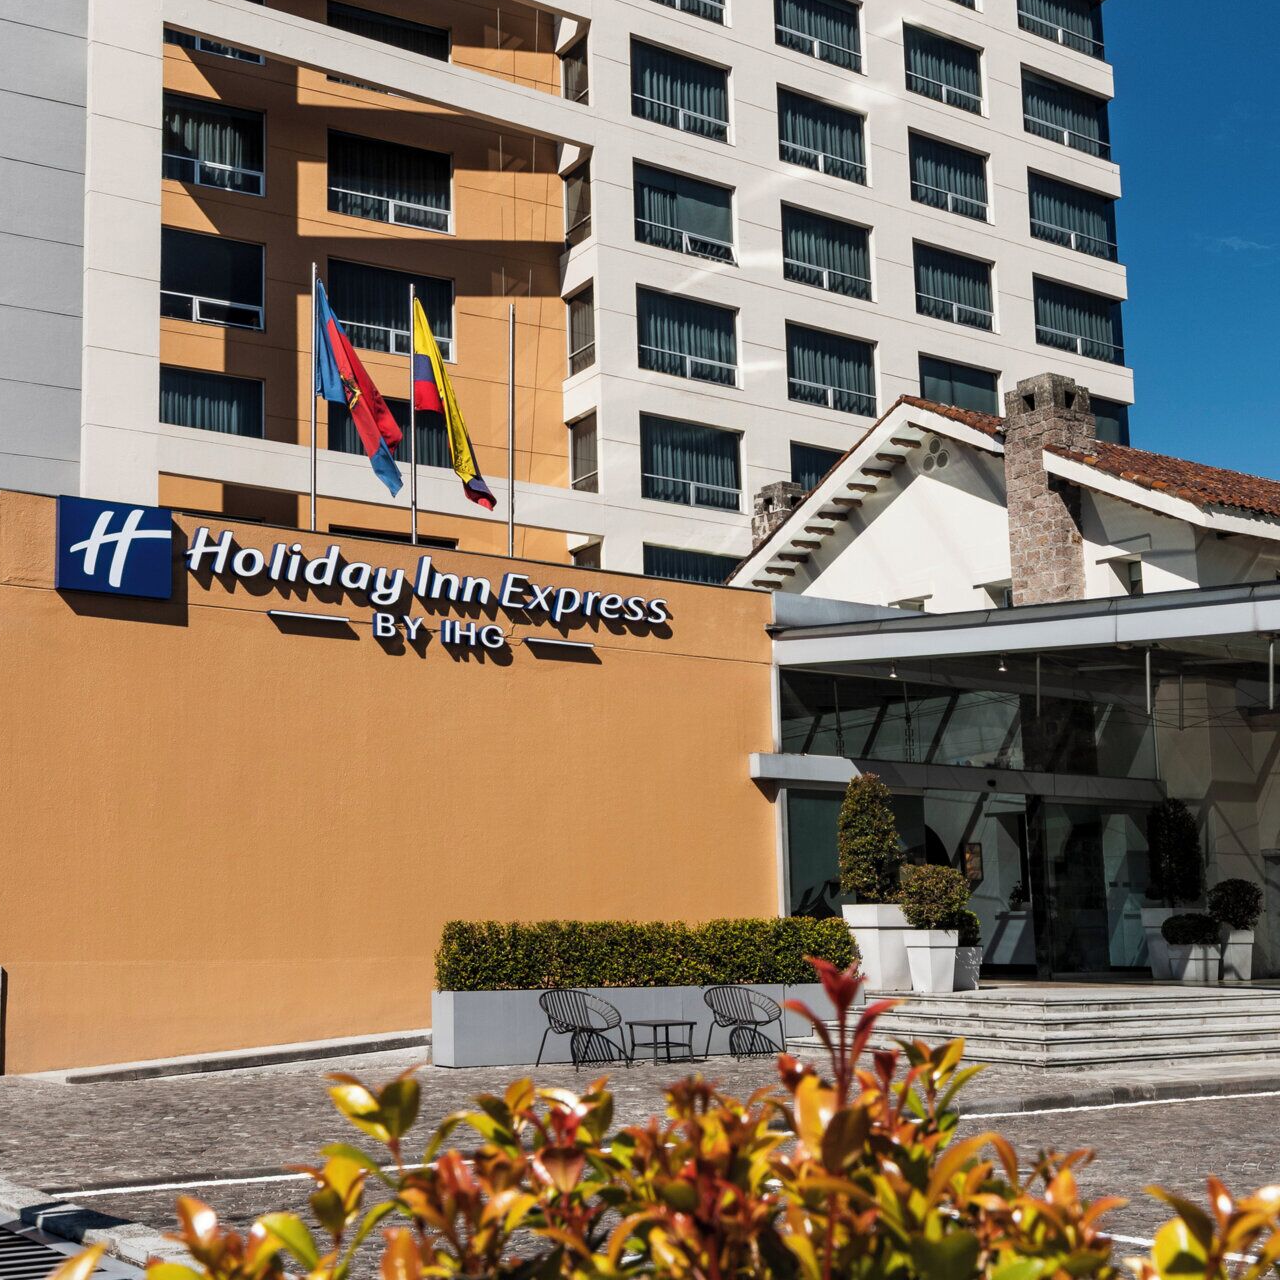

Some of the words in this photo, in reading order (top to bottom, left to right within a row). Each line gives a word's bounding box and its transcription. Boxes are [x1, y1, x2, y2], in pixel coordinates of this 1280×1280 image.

[184, 526, 405, 606] Holiday
[414, 555, 491, 605] Inn
[499, 572, 669, 624] Express
[373, 611, 425, 641] BY
[441, 619, 505, 649] IHG
